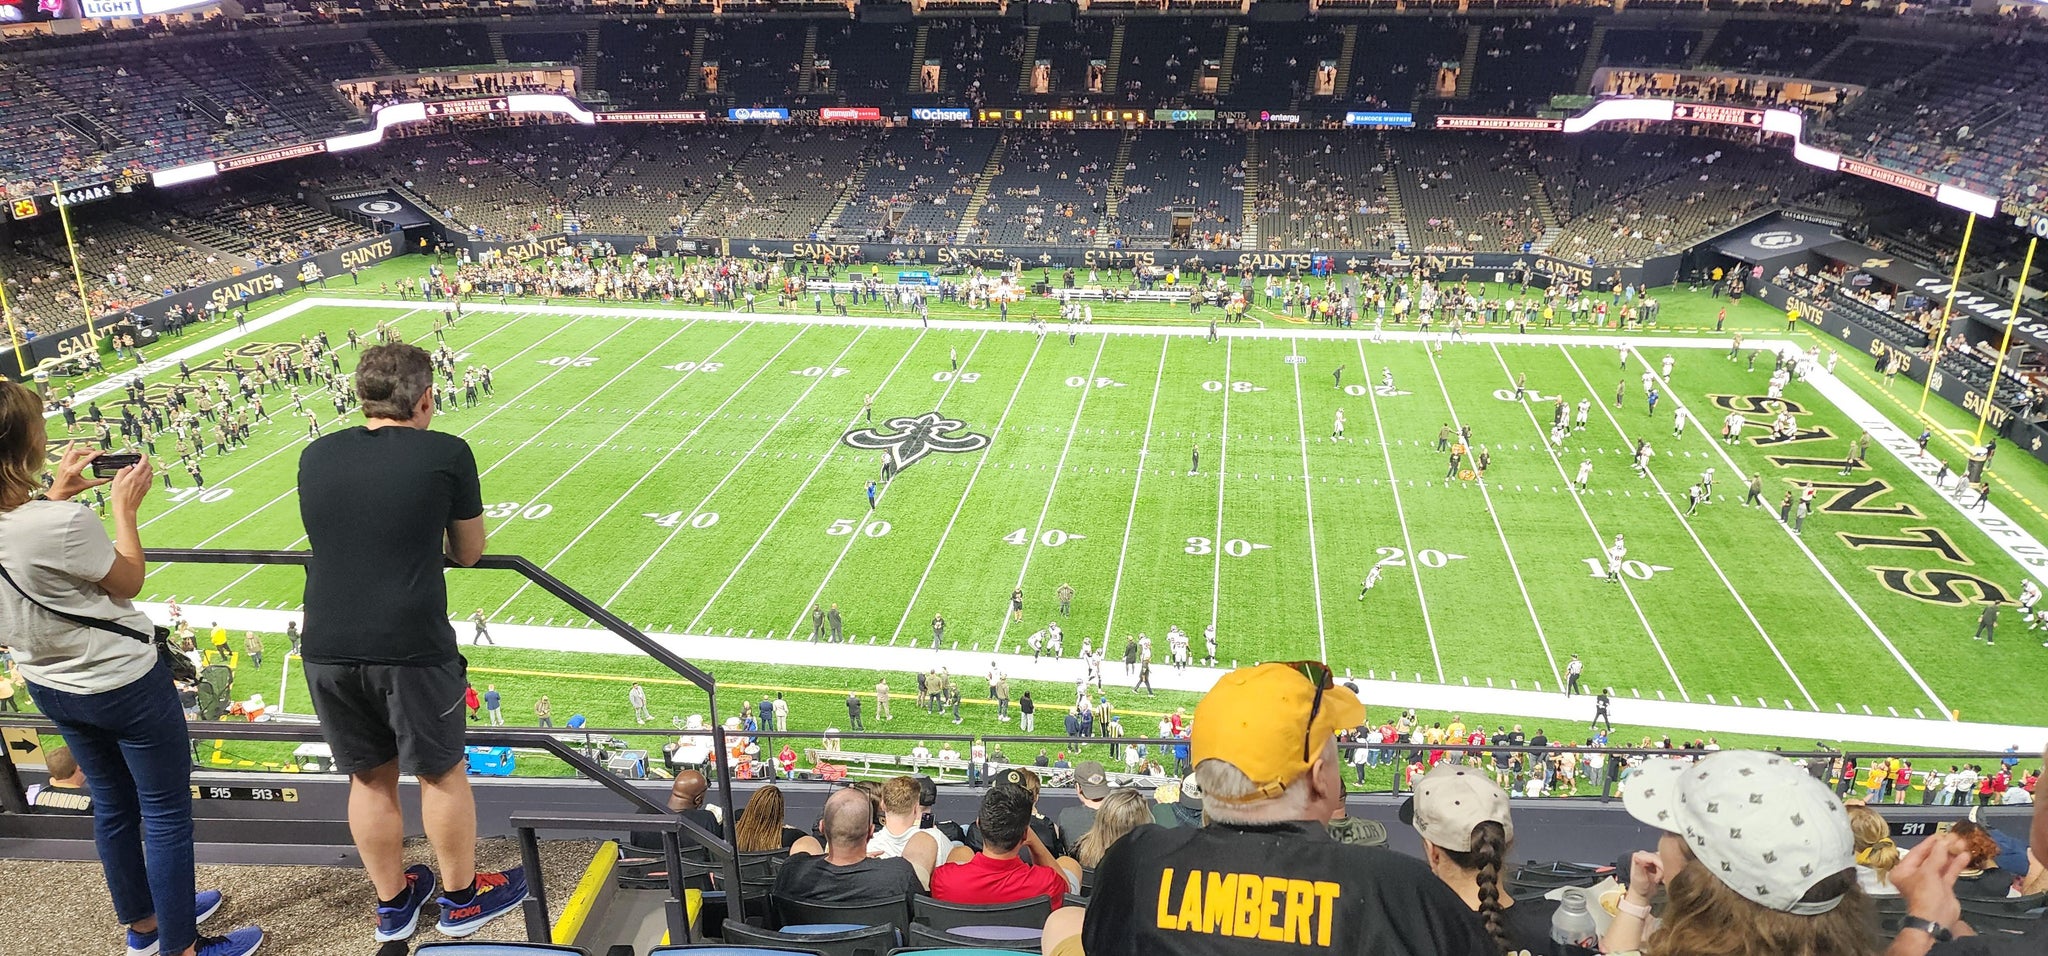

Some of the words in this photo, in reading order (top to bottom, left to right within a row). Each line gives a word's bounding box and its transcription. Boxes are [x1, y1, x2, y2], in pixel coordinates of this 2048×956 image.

[88, 0, 132, 14] LIGHT
[921, 109, 968, 120] Ochsner
[1172, 110, 1198, 121] COX
[1270, 113, 1300, 123] entergy
[115, 174, 147, 188] SAINTS
[2001, 202, 2031, 221] SAINTS
[341, 239, 393, 269] SAINTS
[506, 236, 568, 261] SAINTS
[793, 243, 861, 258] SAINTS
[937, 248, 1005, 263] SNTS
[1238, 252, 1312, 269] SAINTS
[1402, 254, 1474, 269] ANTS
[212, 272, 276, 306] SAINTS
[1785, 297, 1825, 326] SAINTS
[57, 323, 122, 358] SAINT
[1871, 337, 1912, 373] SANTS
[932, 371, 981, 383] 50
[1706, 393, 2024, 607] SAINTS
[488, 501, 553, 520] 30
[653, 510, 720, 529] 40
[826, 519, 891, 538] 50
[1002, 527, 1070, 548] 40
[1184, 537, 1252, 558] 30
[1977, 518, 2023, 538] OF
[2011, 545, 2048, 567] US
[1375, 546, 1449, 569] 20
[1581, 557, 1655, 580] 10
[210, 787, 231, 798] 515
[251, 788, 274, 800] 513
[1902, 823, 1926, 835] 511
[449, 904, 482, 920] HOKA
[1156, 867, 1341, 947] LAMBERT
